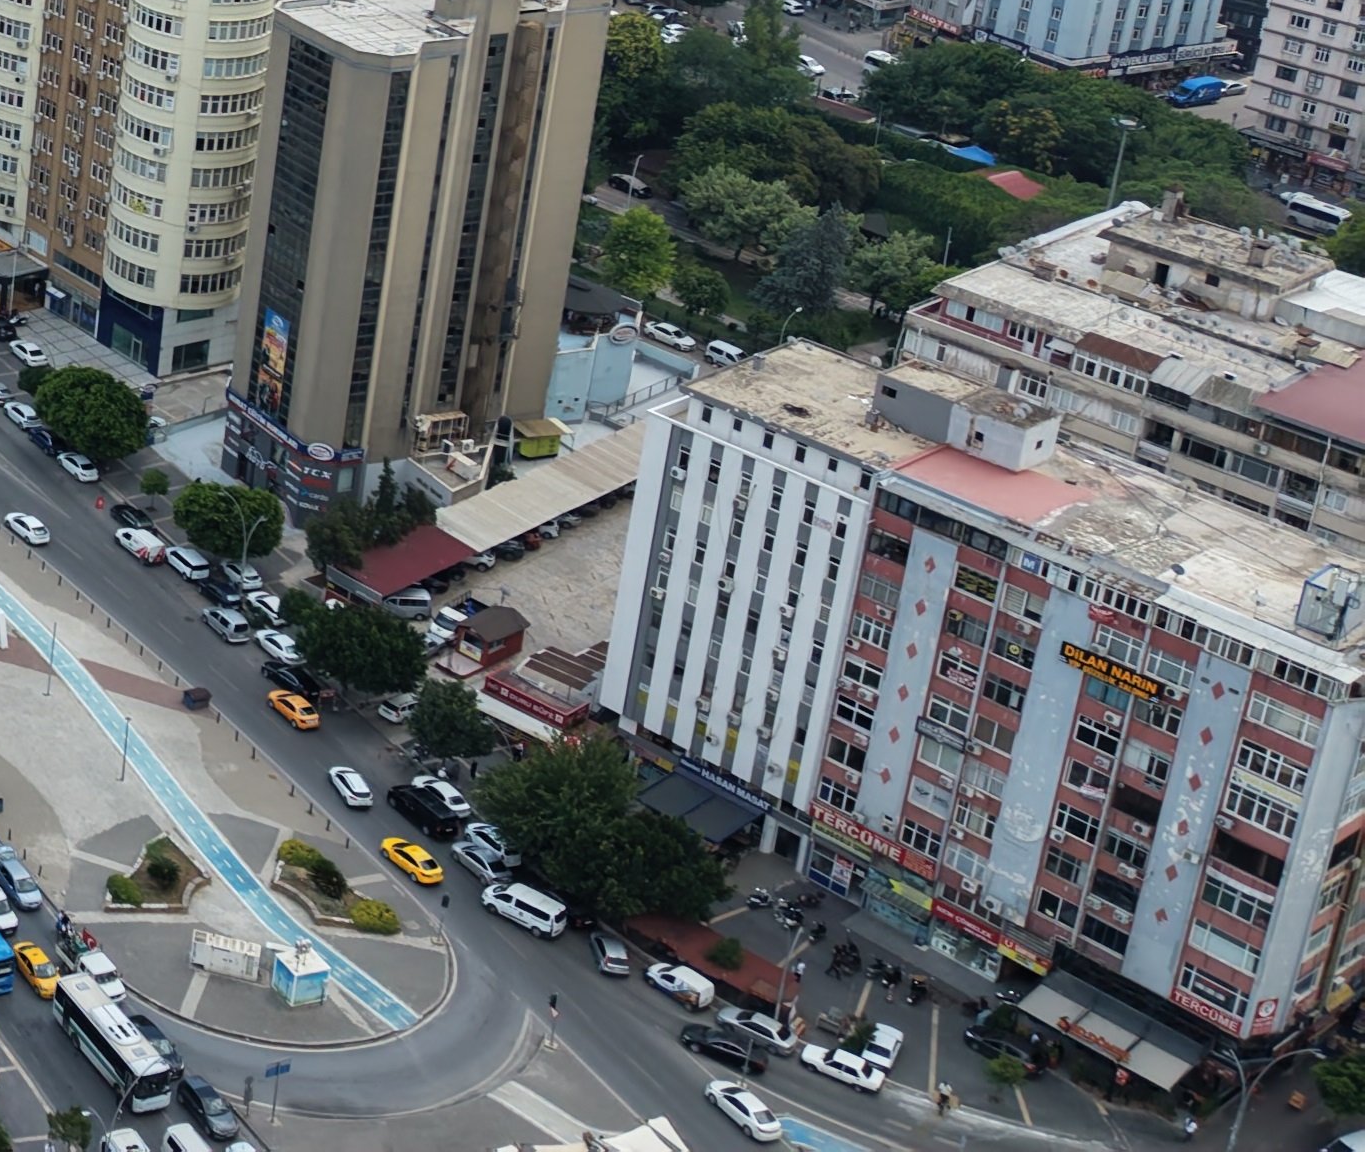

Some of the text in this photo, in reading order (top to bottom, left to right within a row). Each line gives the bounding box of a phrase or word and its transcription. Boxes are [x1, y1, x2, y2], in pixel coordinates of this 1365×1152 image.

[921, 13, 958, 33] NOTER
[812, 805, 902, 863] TERCÜME
[1173, 989, 1240, 1032] TERCÜME
